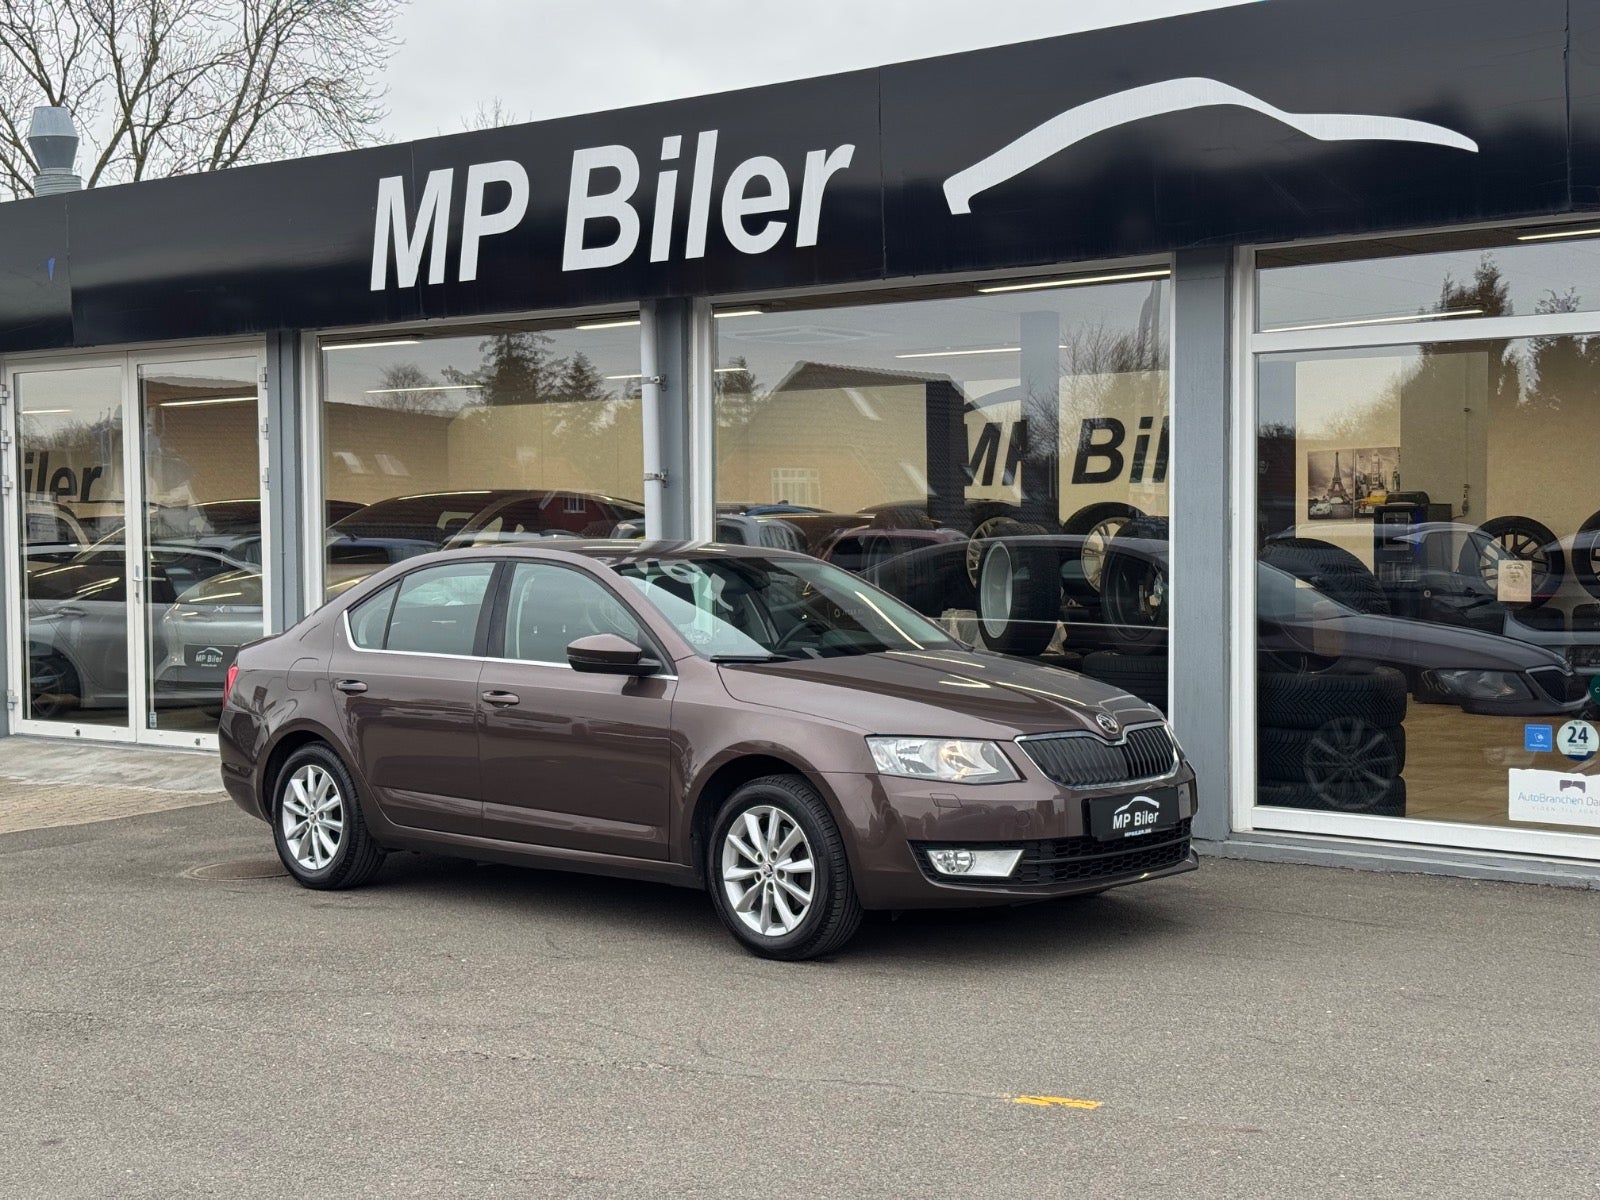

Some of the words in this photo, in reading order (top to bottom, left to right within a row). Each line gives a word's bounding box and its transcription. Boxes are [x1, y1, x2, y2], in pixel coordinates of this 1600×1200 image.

[370, 159, 530, 292] MP
[561, 129, 856, 272] Biler
[1567, 726, 1589, 744] 24
[1517, 791, 1584, 806] AutoBranchen
[1586, 796, 1600, 807] Da
[1113, 813, 1131, 829] MP
[1134, 810, 1159, 826] Biler
